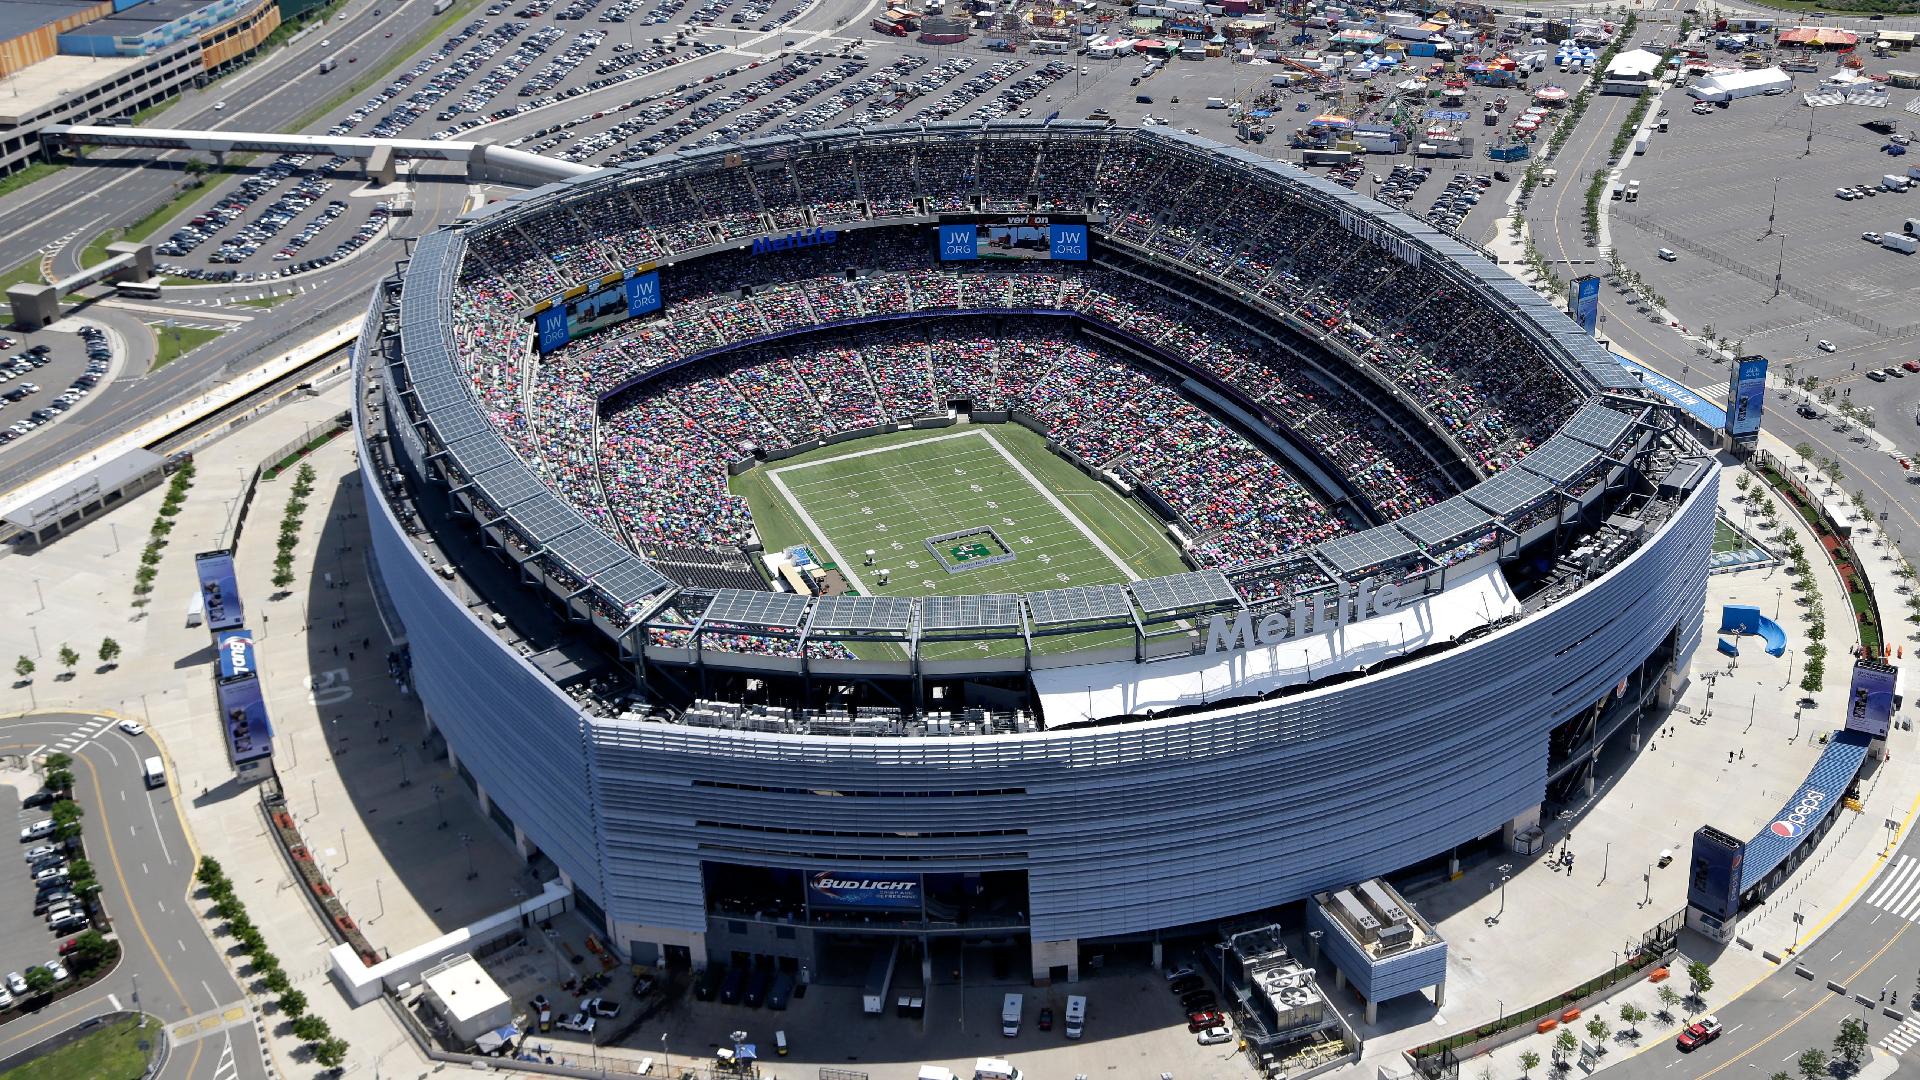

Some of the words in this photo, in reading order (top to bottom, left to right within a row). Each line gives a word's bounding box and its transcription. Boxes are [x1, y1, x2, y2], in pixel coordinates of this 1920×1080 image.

[1008, 215, 1049, 226] verizon
[752, 226, 837, 256] MetLife
[947, 231, 970, 244] JW
[1057, 231, 1081, 244] JW
[945, 245, 971, 255] .ORG
[1055, 244, 1081, 254] .ORG
[633, 281, 653, 298] JW
[632, 295, 656, 310] .ORG
[545, 314, 561, 334] JW
[544, 329, 564, 346] .ORG
[1205, 577, 1400, 656] MetLife
[230, 641, 246, 666] BUD
[1788, 789, 1826, 826] pepsi
[818, 879, 860, 889] BUD
[860, 880, 917, 890] LIGHT
